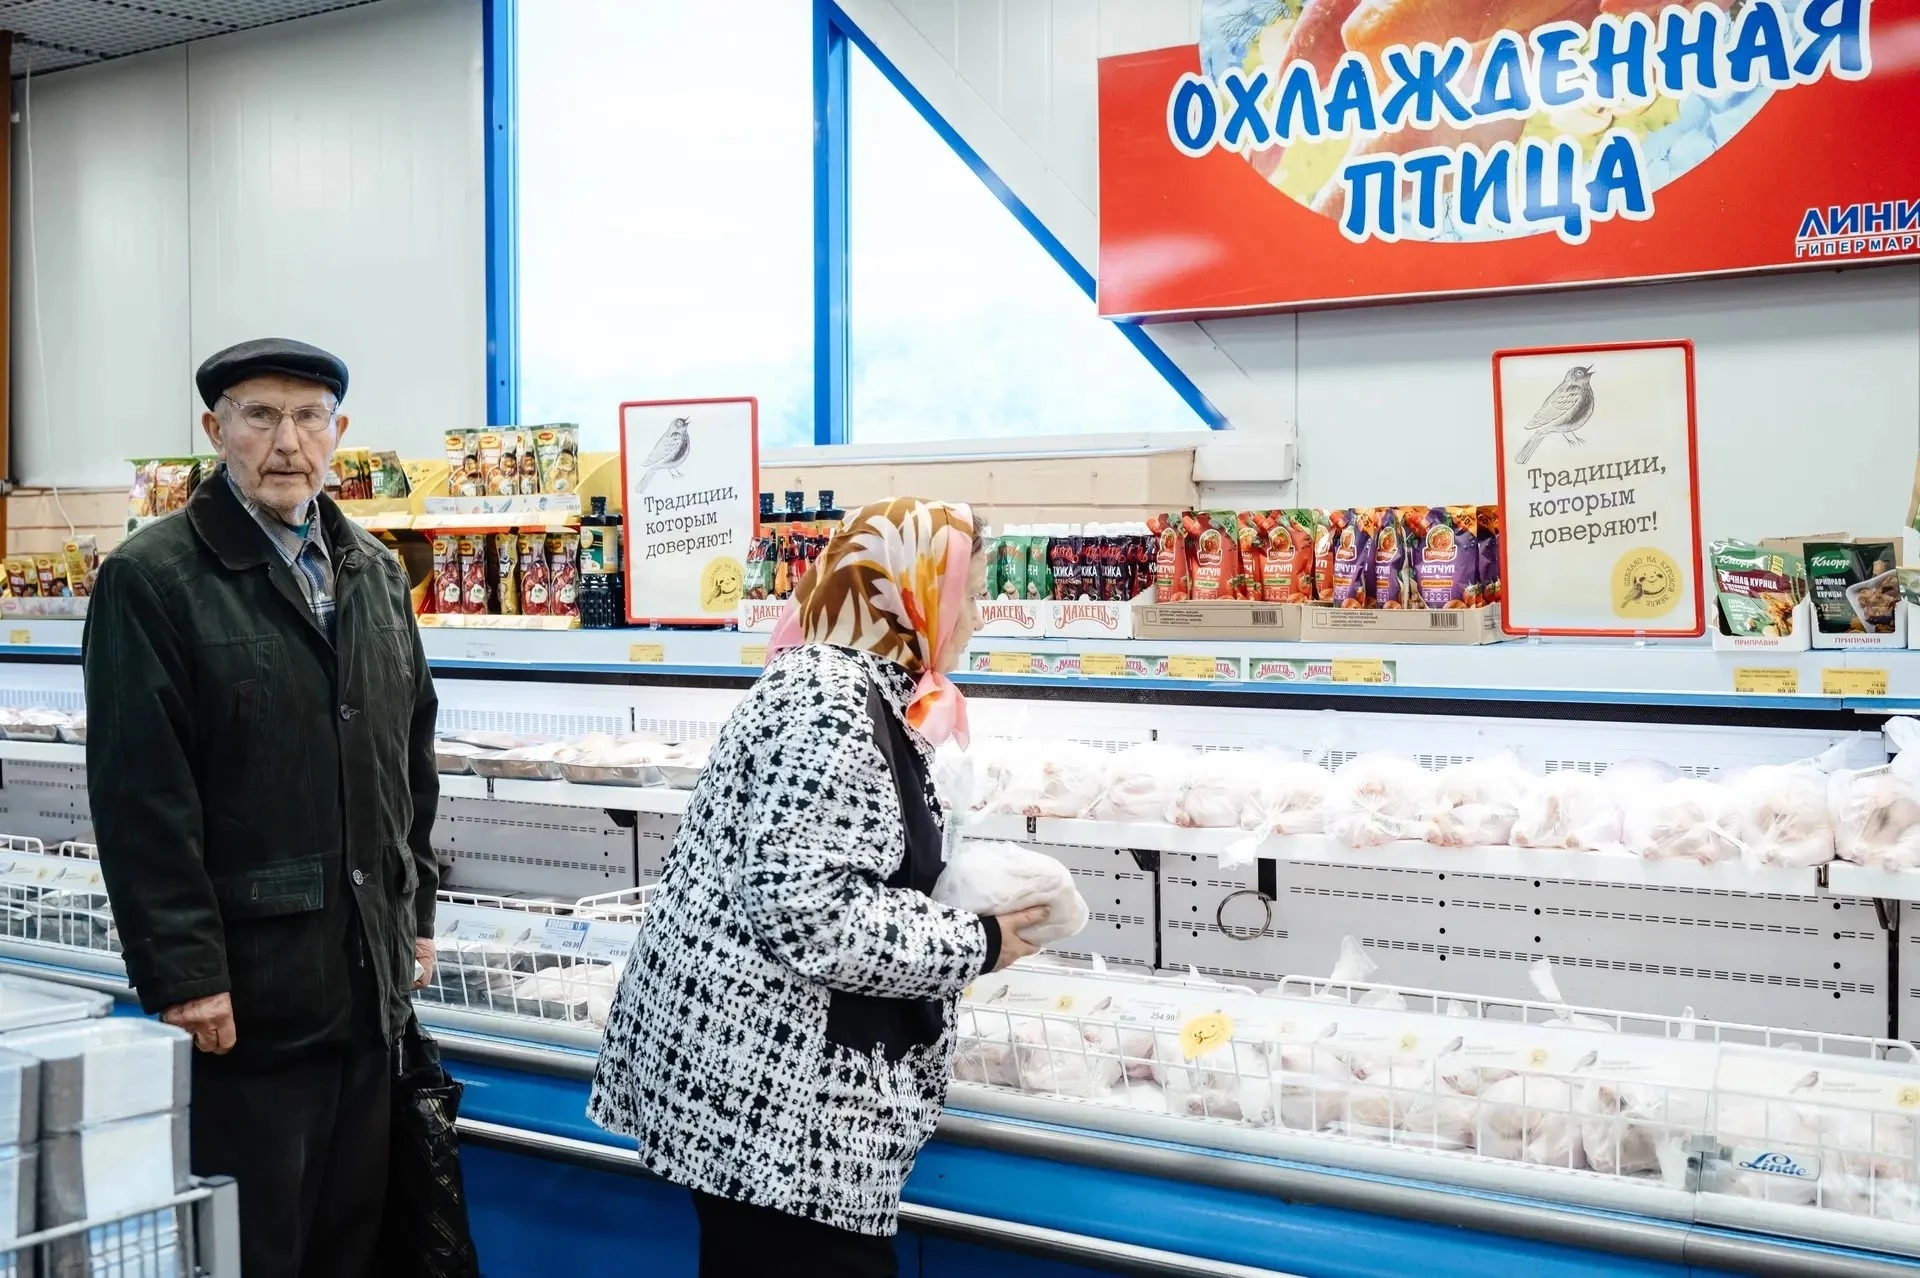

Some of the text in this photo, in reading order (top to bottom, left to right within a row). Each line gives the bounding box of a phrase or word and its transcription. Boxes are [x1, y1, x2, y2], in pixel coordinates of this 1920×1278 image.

[1172, 0, 1867, 151] ОХЛАЖДЕННАЯ
[1343, 134, 1648, 236] ПТИЦА
[1796, 236, 1920, 257] ГИПЕРМАР
[1527, 456, 1667, 493] Традиции,
[643, 486, 739, 516] Традиции,
[1528, 488, 1636, 517] которым
[645, 511, 718, 535] которым
[1529, 511, 1659, 550] доверяют!
[645, 528, 733, 560] доверяют!
[1263, 563, 1293, 573] КЕТЧУП
[1420, 564, 1455, 574] КЕТЧУП
[1646, 555, 1657, 564] НА
[1810, 556, 1851, 570] Кнорр
[1722, 574, 1749, 585] ОЧНАЯ
[1750, 577, 1778, 590] КУРИЦА
[1054, 604, 1119, 630] МАХЕЕВЪ
[1734, 639, 1779, 647] ПРИПРАВИЯ
[1150, 1012, 1176, 1021] 254.99
[1739, 1152, 1809, 1176] Linde
